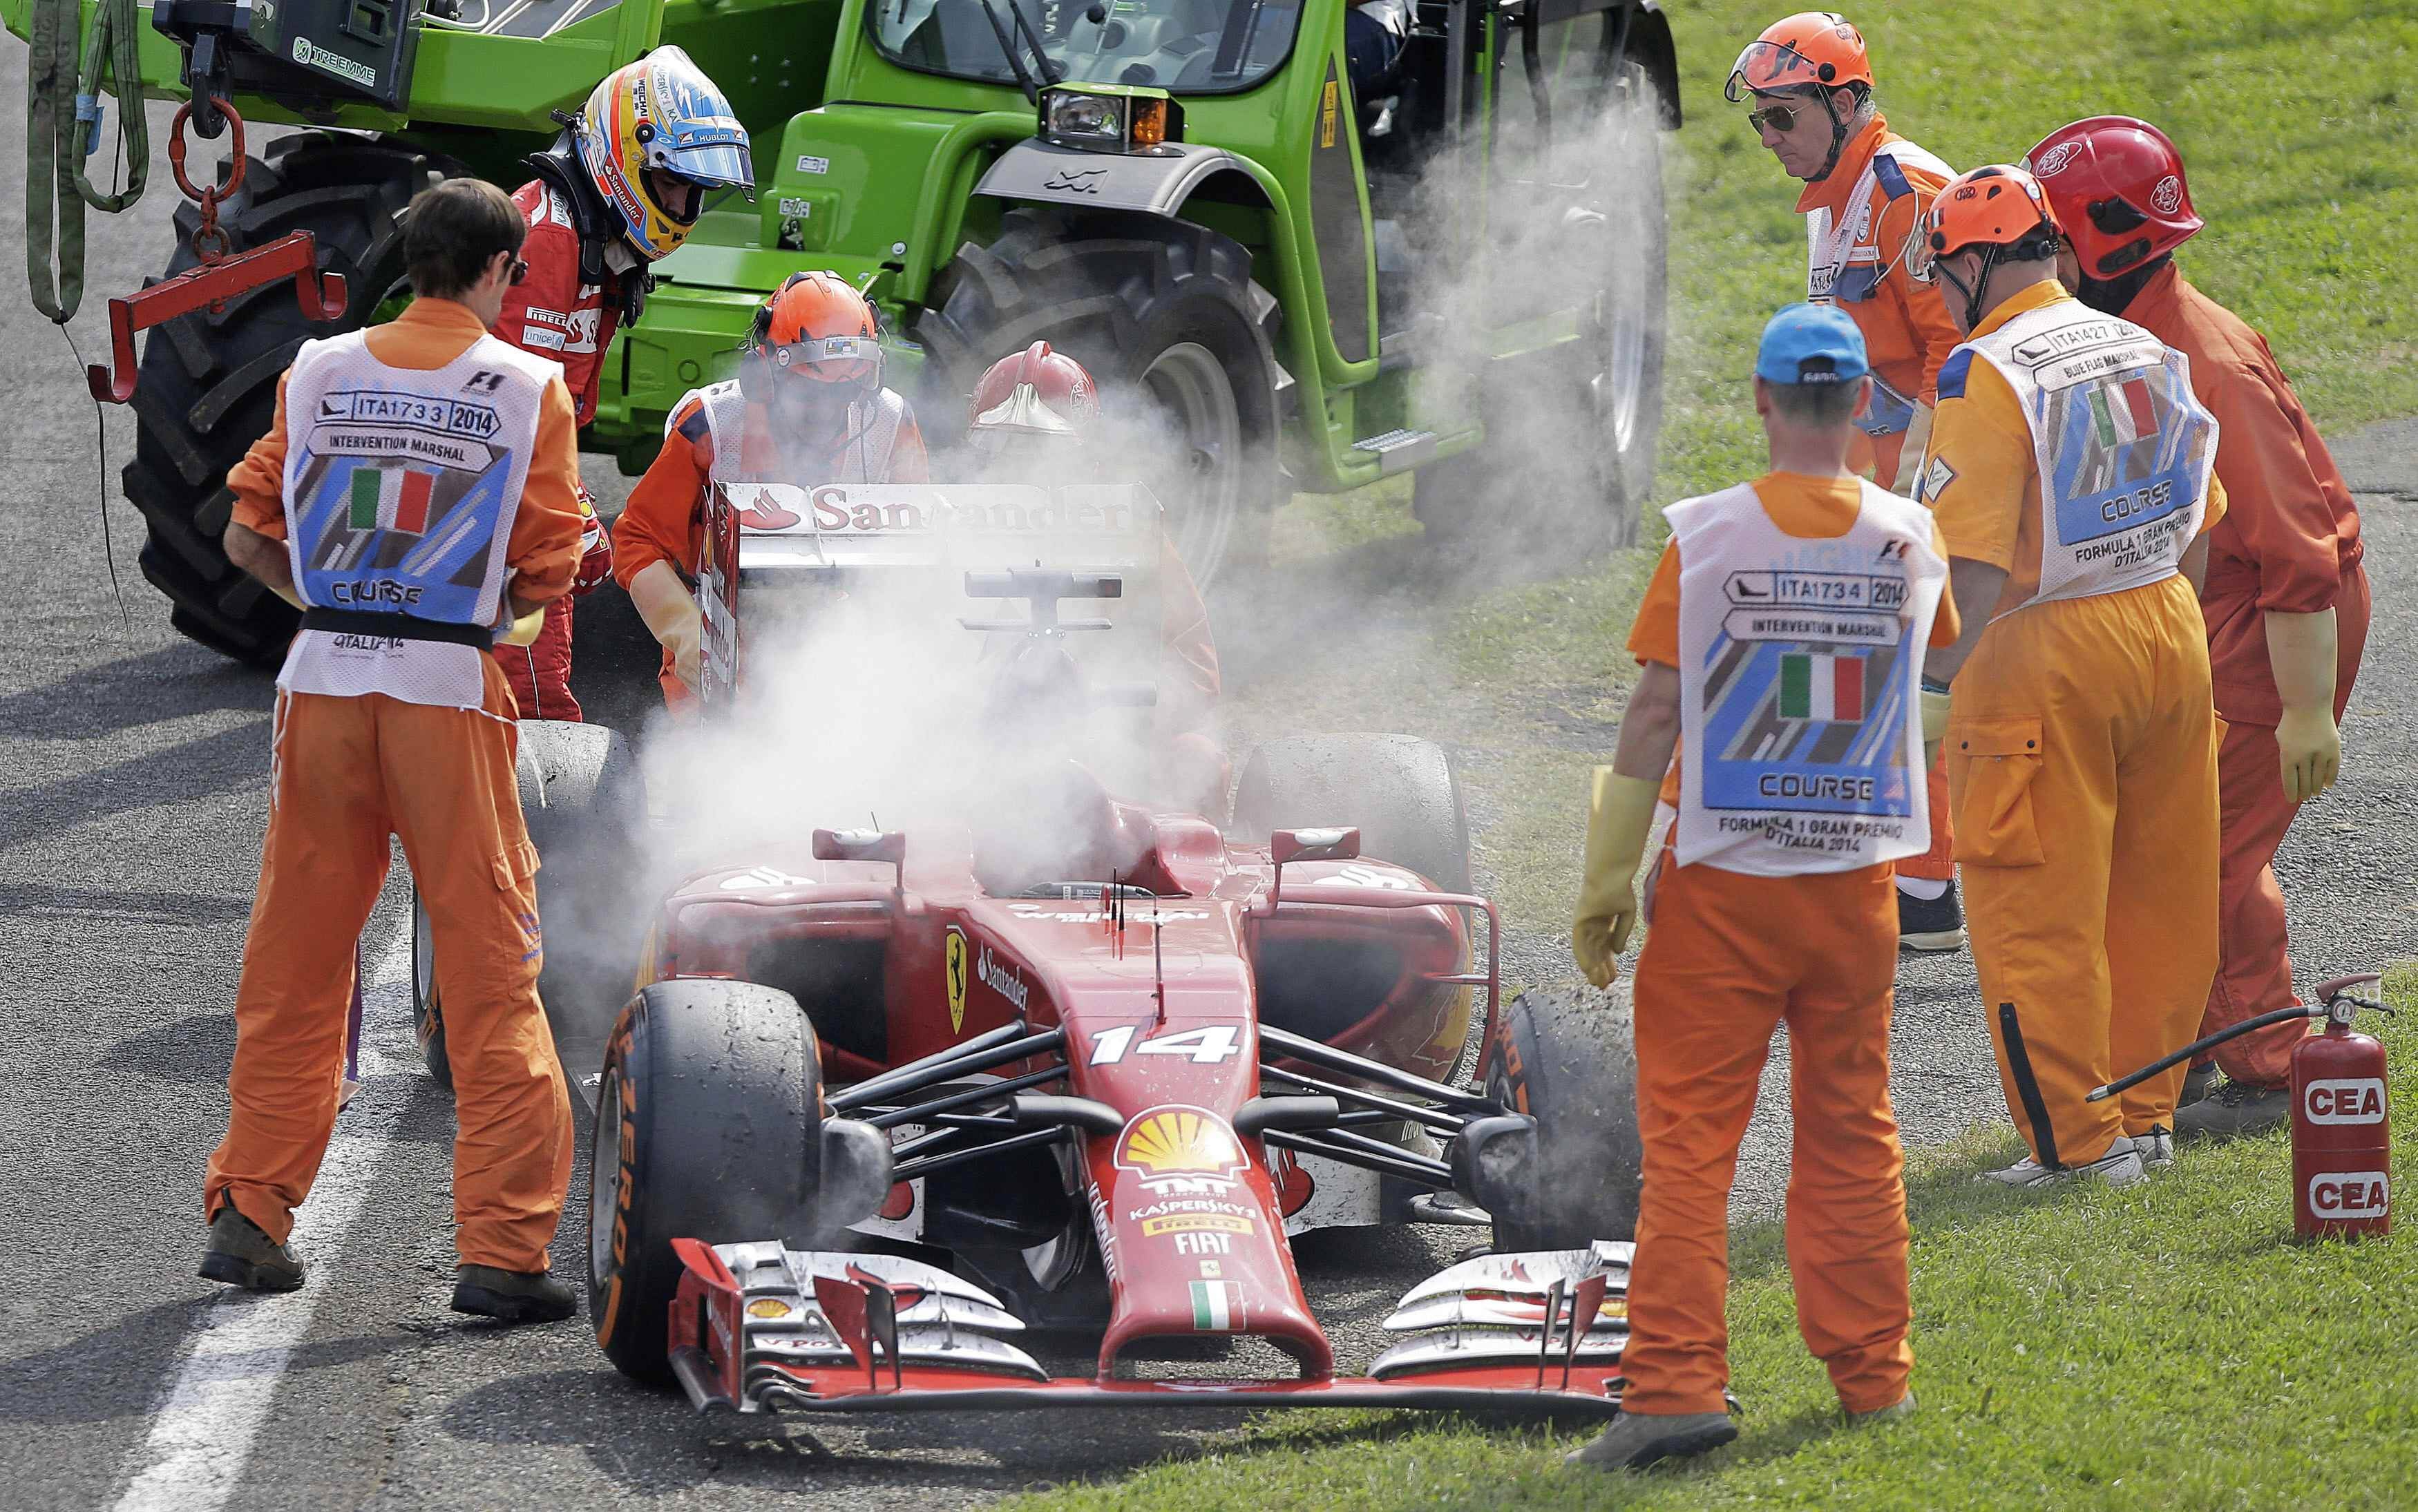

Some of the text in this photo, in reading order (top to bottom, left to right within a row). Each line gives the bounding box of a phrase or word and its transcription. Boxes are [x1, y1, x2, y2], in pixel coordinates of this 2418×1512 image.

[638, 78, 648, 117] WEICHAI
[698, 134, 730, 142] HUBLOT
[609, 173, 640, 220] Santander
[526, 306, 567, 327] PIRELL
[2052, 326, 2109, 348] ITA1427
[2064, 363, 2087, 379] BLUE
[2085, 356, 2104, 372] FLAG
[358, 399, 492, 434] ITA1733 2014
[330, 435, 466, 461] INTERVENTION MARSHAL
[2075, 536, 2136, 563] FORMULA
[1781, 580, 1904, 603] ITA1734 2014
[1752, 619, 1886, 638] INTERVENTION MARSHAL
[1759, 773, 1875, 801] COURSE
[1719, 816, 1793, 832] FORMULA
[1810, 819, 1849, 835] GRAN
[1764, 825, 1860, 853] D'ITALIA 2014
[987, 947, 1028, 1011] Santander
[1089, 1025, 1239, 1067] 14
[2308, 1087, 2382, 1116] CEA
[1138, 1177, 1239, 1195] TNT
[2315, 1180, 2386, 1210] CEA
[1174, 1232, 1232, 1254] FIAT
